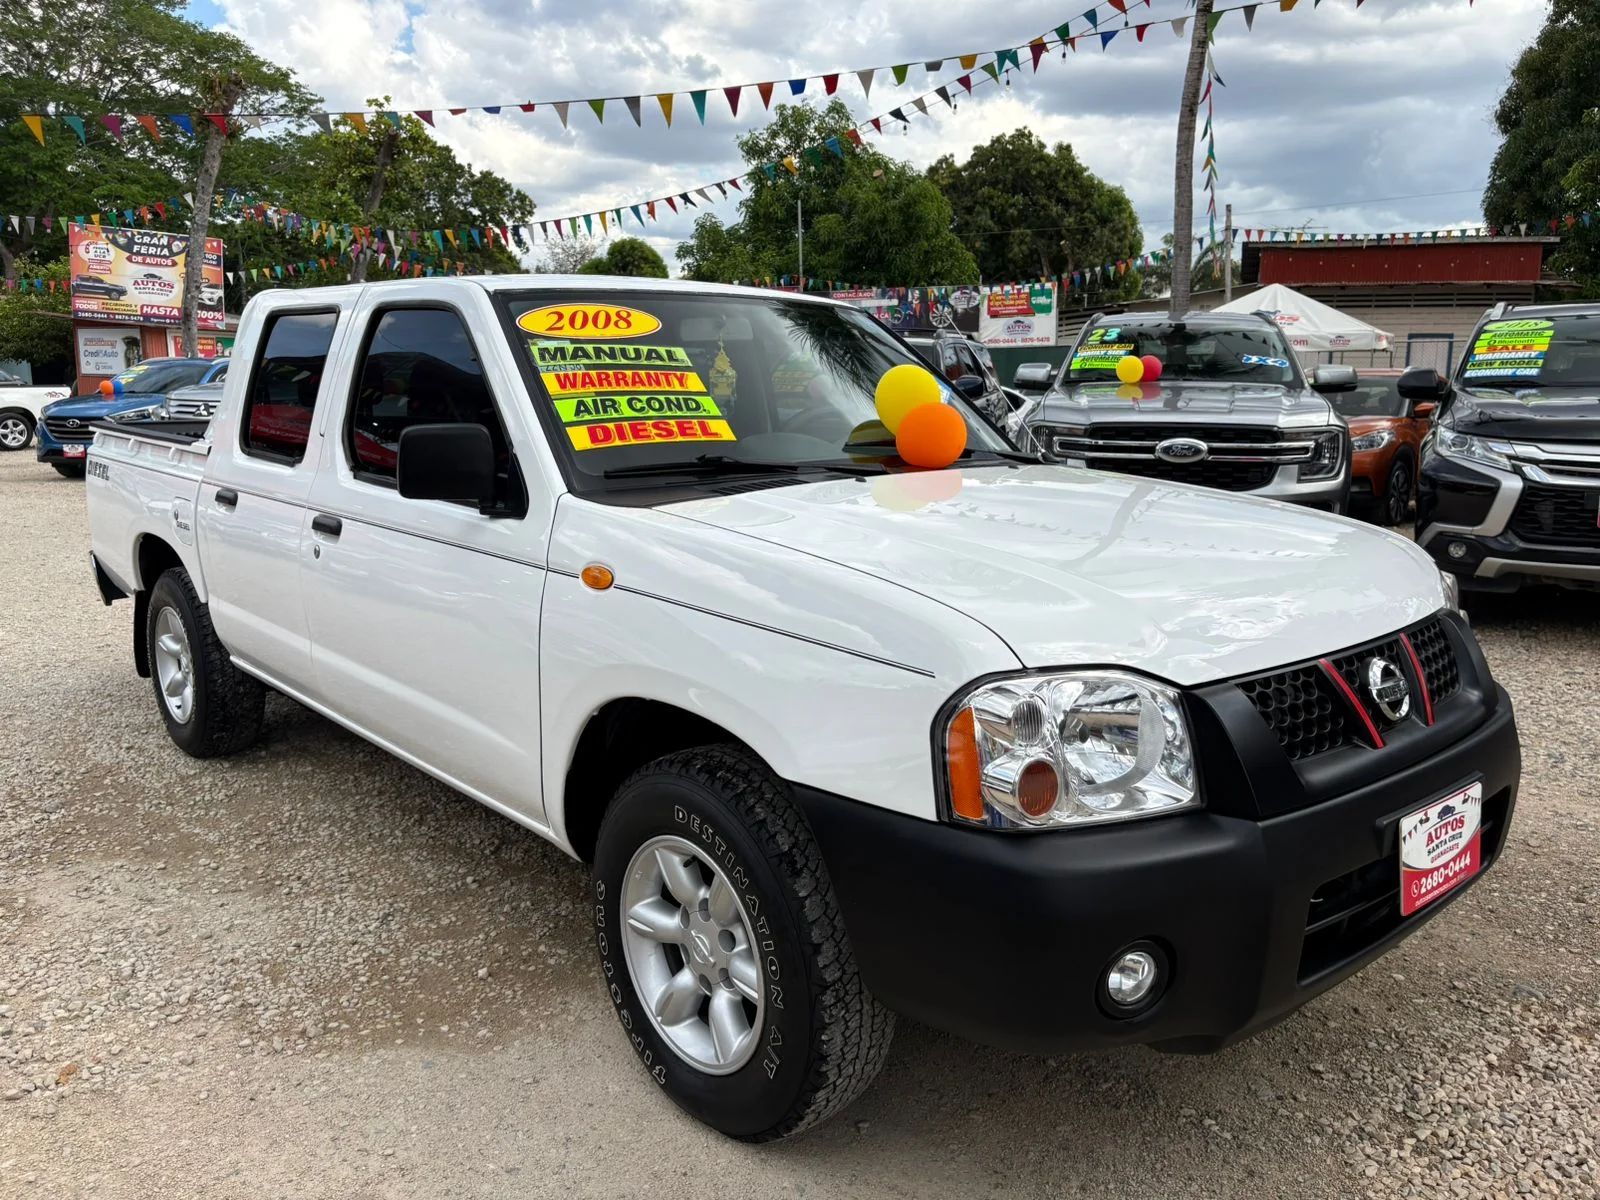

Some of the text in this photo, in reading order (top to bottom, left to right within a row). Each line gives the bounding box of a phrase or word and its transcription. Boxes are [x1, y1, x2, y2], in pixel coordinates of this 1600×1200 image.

[134, 235, 168, 246] GRAN
[133, 245, 169, 256] FERIA
[145, 257, 172, 266] AUTOS
[132, 280, 174, 289] AUTOS
[143, 306, 179, 316] HASTA
[545, 309, 633, 332] 2008
[1490, 330, 1545, 338] AUTOMATIC
[538, 346, 688, 364] MANUAL
[1475, 351, 1540, 360] WARRANTY
[554, 371, 689, 391] WARRANTY
[1464, 368, 1540, 377] ECONOMY CAR
[573, 396, 710, 418] AIR COND.
[586, 419, 723, 445] DIESEL
[1425, 815, 1466, 848] AUTOS
[1427, 831, 1463, 856] SANTA CRUZ
[1419, 850, 1471, 895] 2680-0444
[674, 804, 784, 1078] DESTINATION A/T
